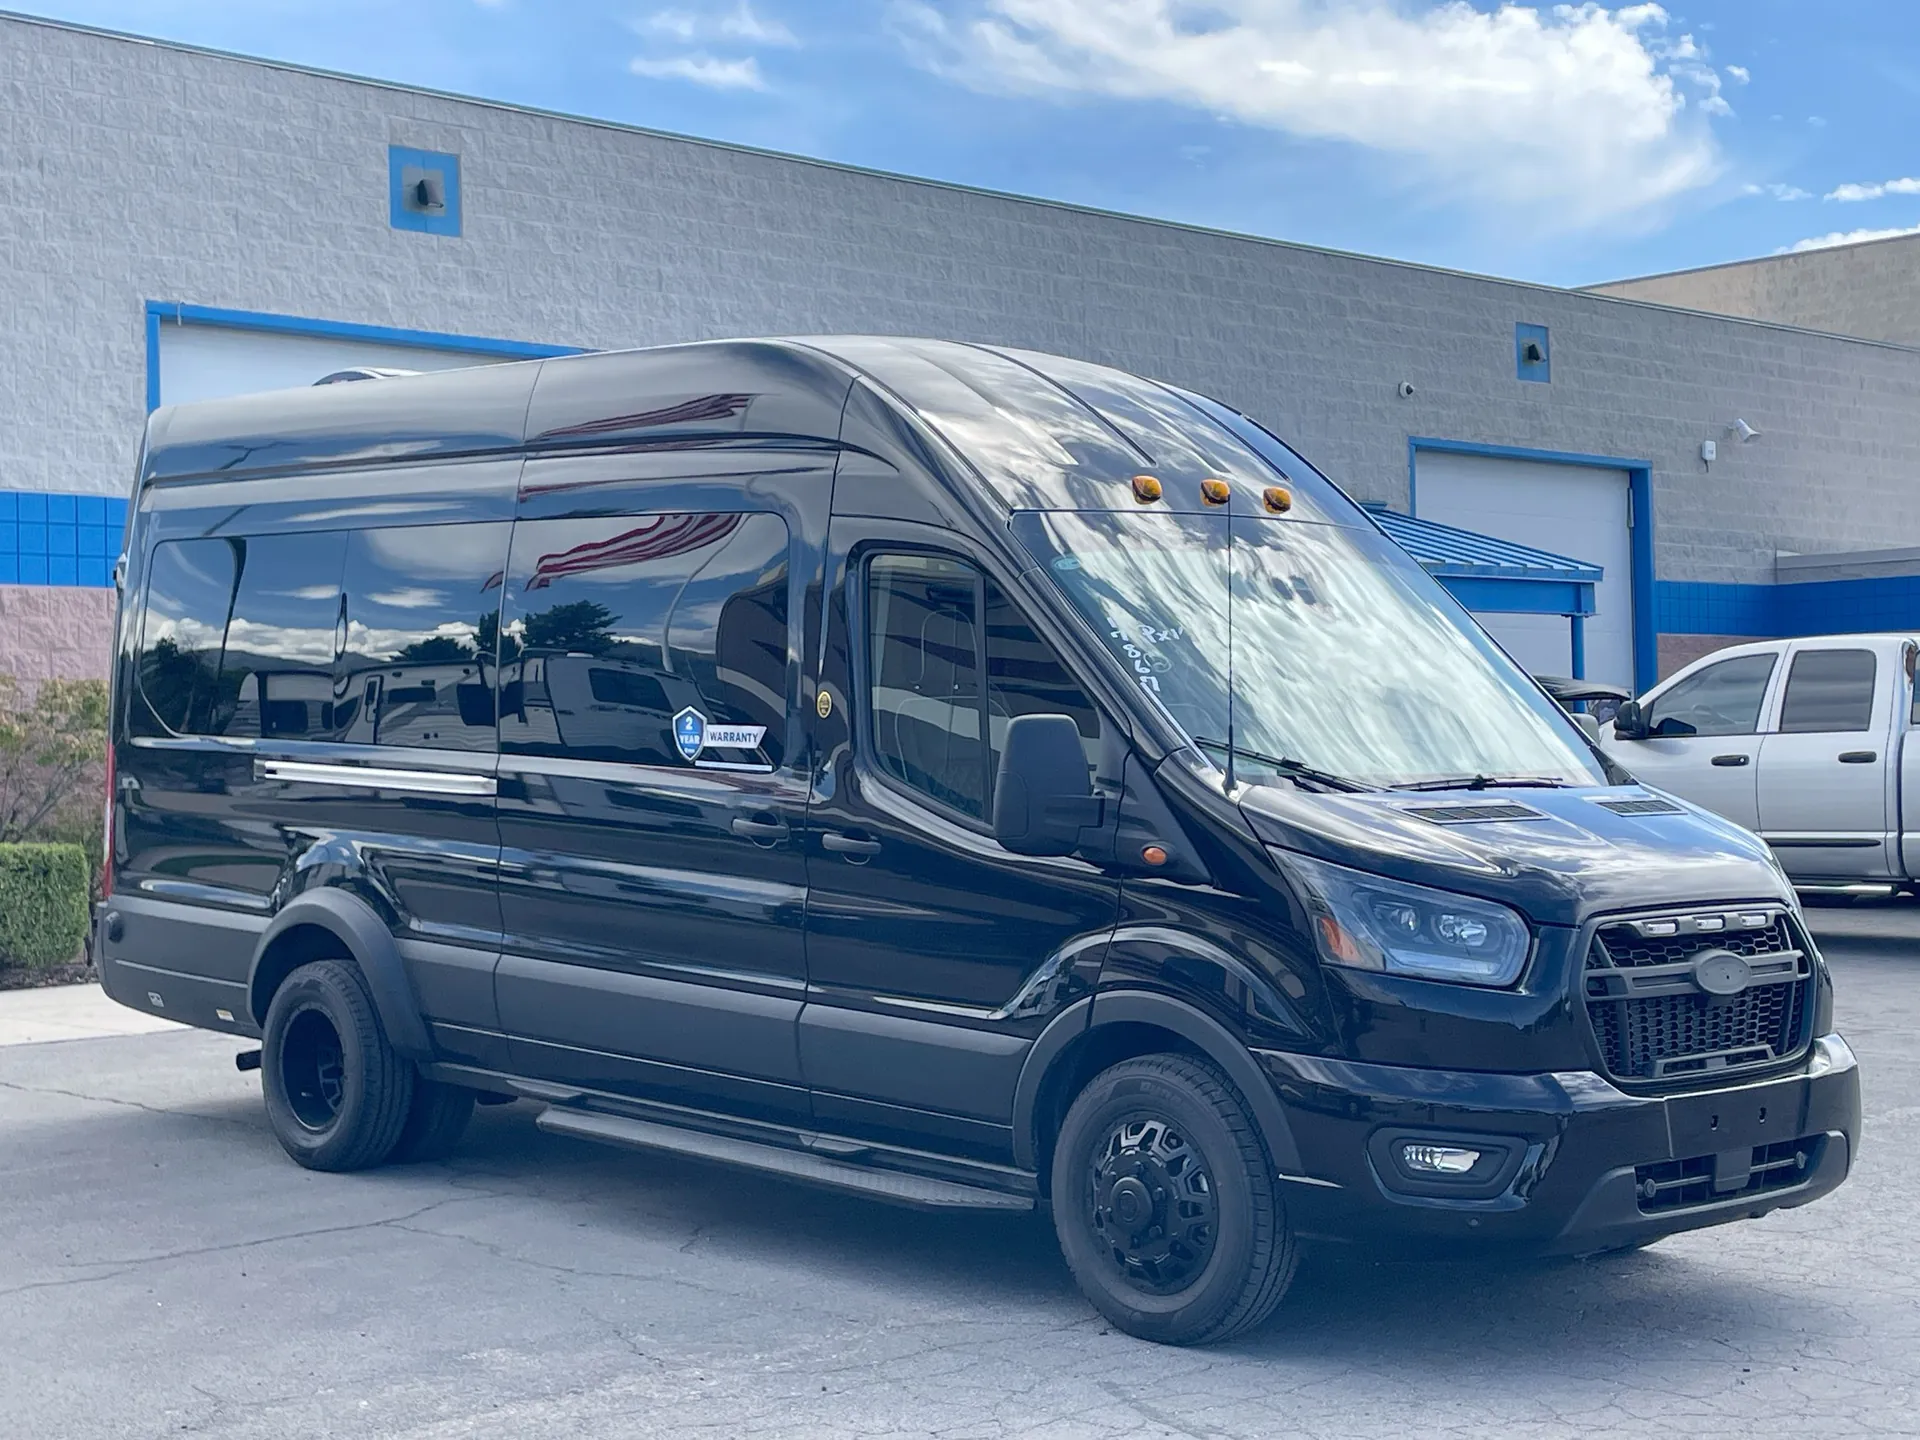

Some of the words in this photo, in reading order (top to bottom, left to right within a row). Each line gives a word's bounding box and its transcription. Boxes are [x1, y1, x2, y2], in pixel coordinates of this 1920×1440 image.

[685, 716, 693, 730] 2
[680, 735, 700, 745] YEAR
[710, 731, 758, 743] WARRANTY
